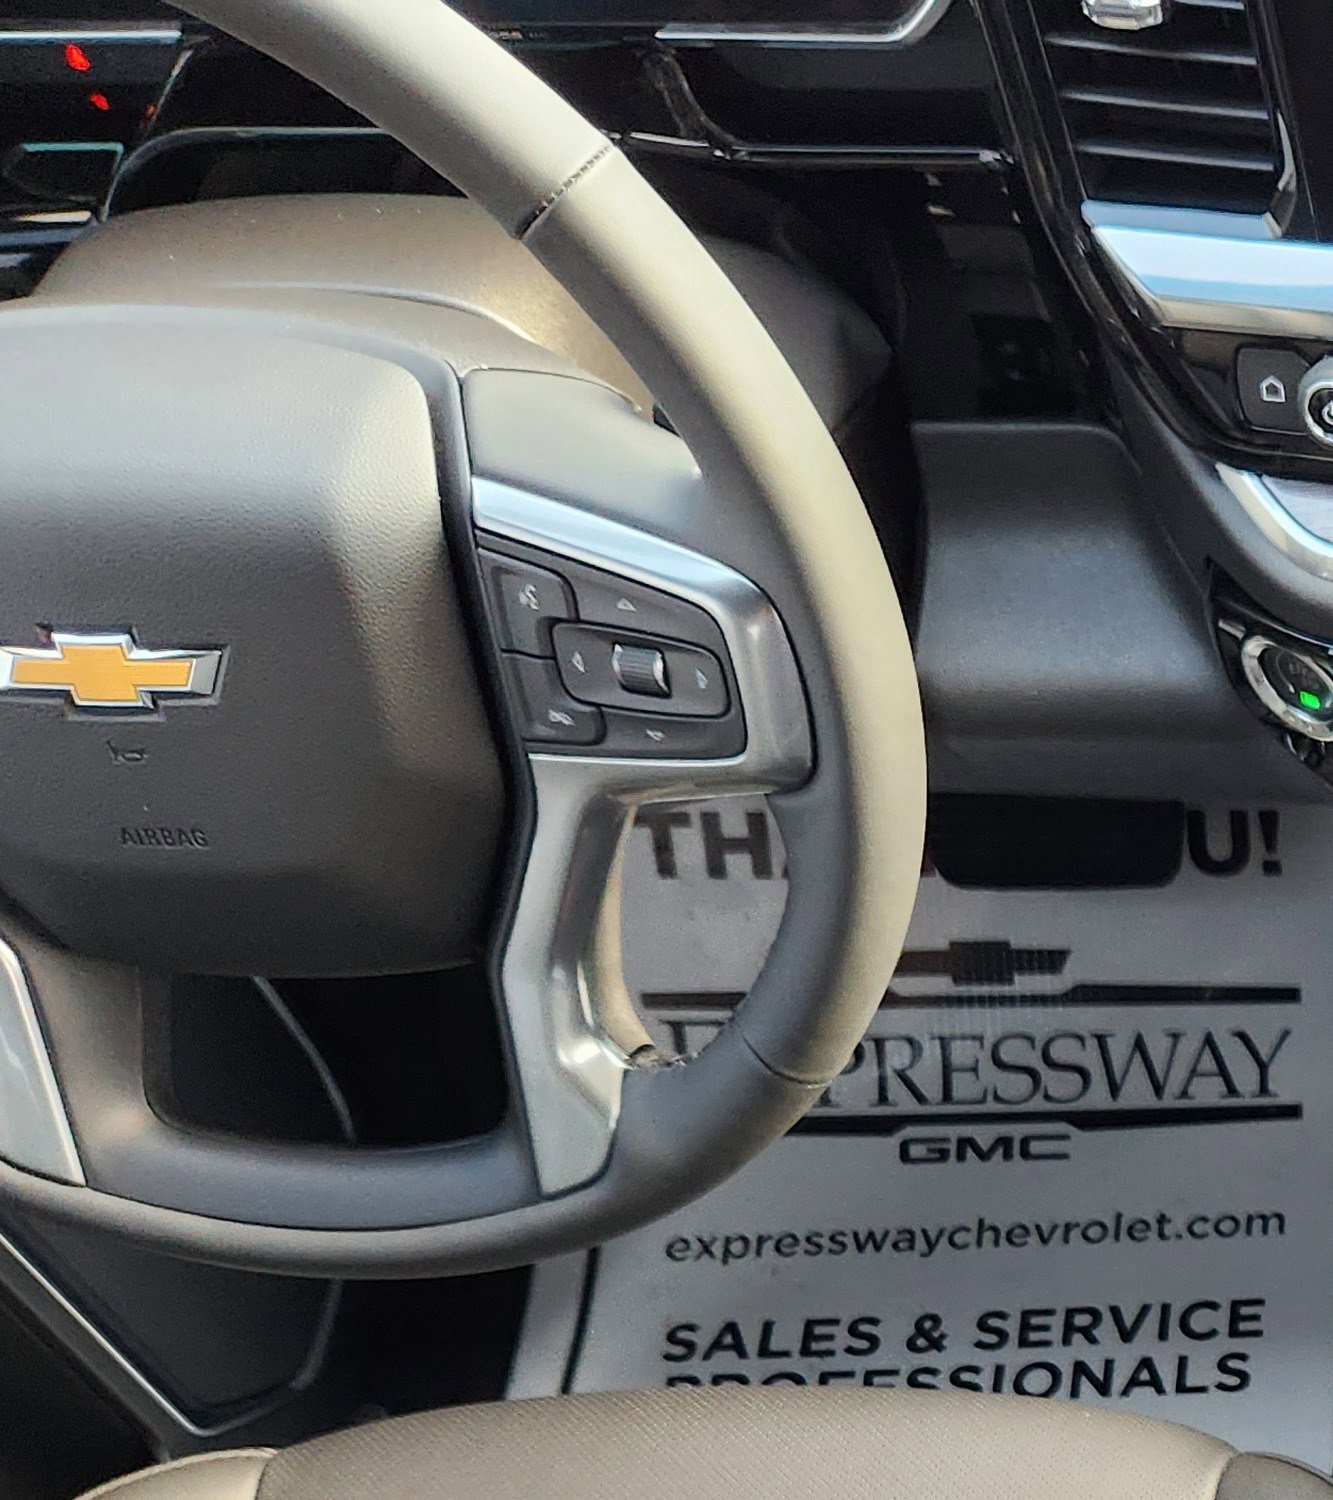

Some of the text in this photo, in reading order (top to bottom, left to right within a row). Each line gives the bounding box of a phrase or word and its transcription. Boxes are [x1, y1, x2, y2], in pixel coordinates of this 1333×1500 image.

[119, 825, 211, 849] AIRBAG
[1185, 807, 1284, 878] U!
[898, 1132, 1073, 1165] GMC
[664, 1206, 1286, 1265] expresswaychevrolet.com
[662, 1298, 1267, 1363] SALES & SERVICE
